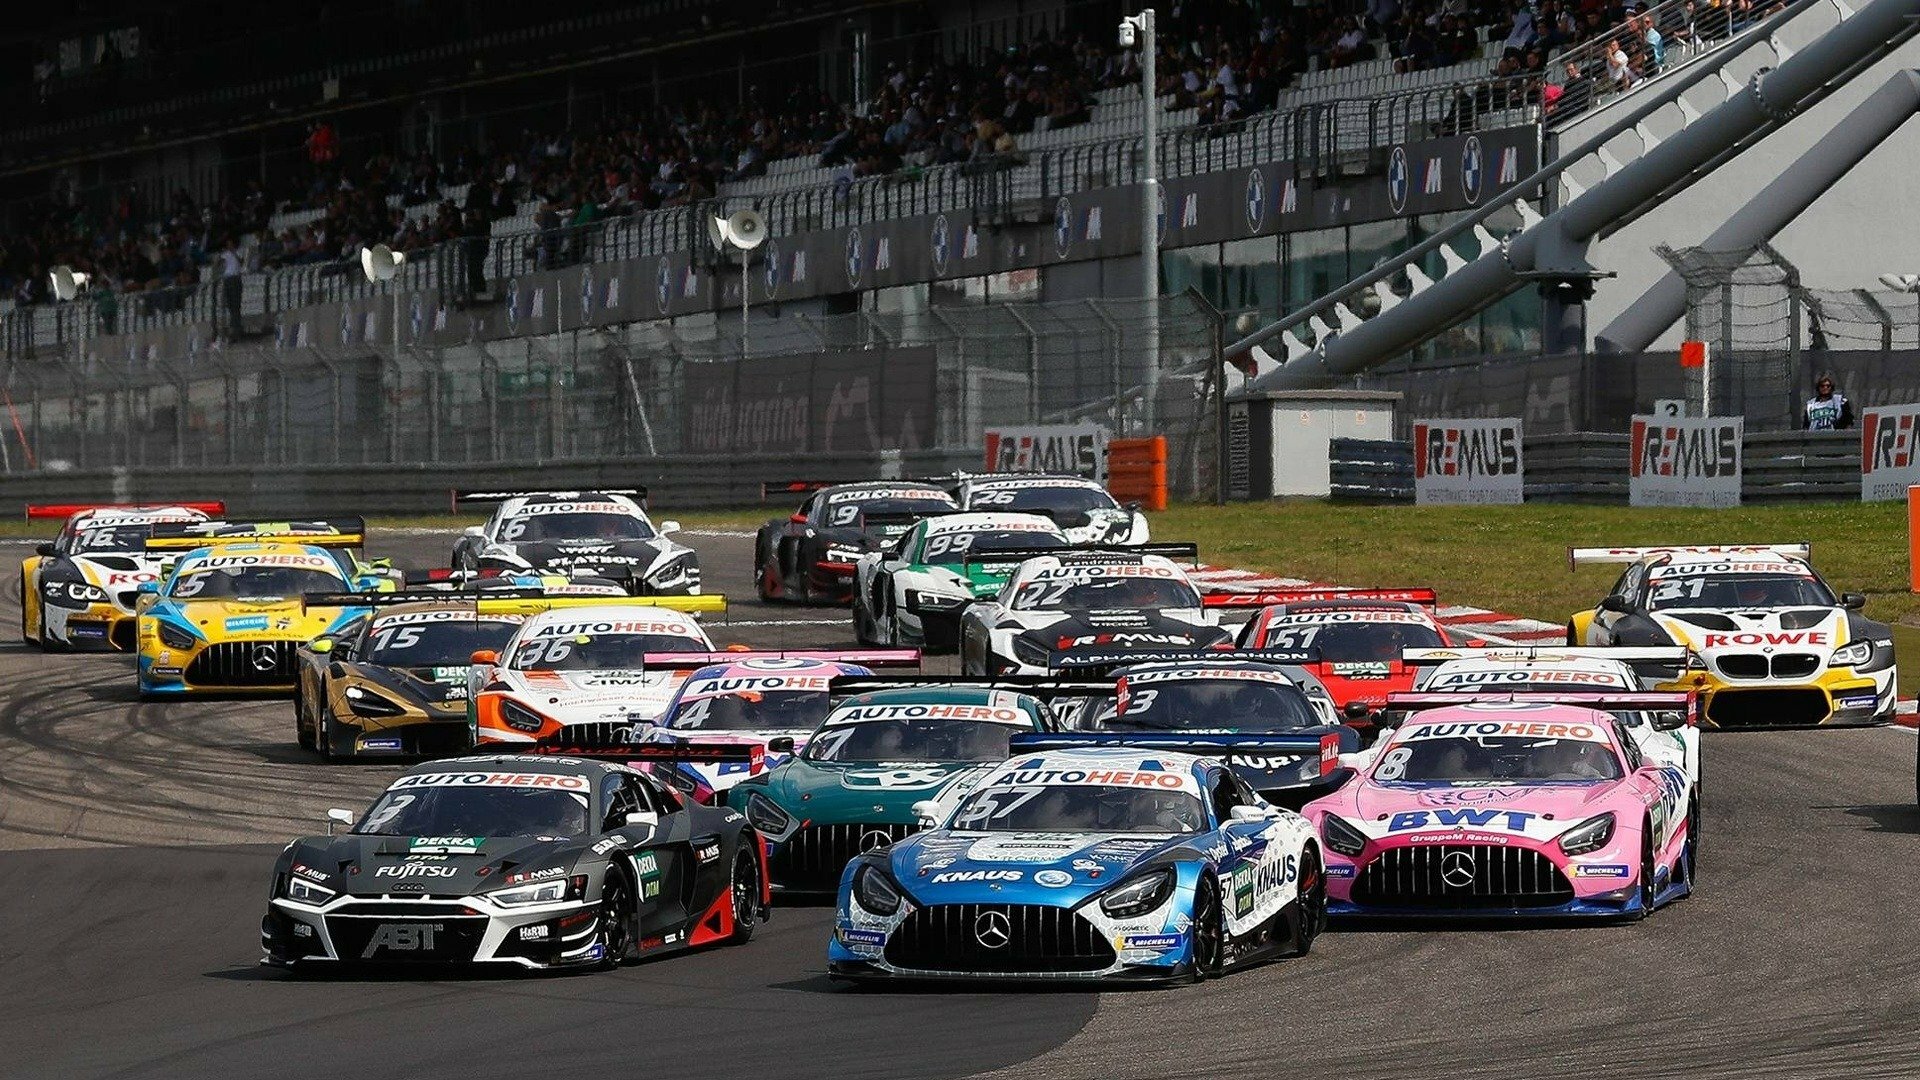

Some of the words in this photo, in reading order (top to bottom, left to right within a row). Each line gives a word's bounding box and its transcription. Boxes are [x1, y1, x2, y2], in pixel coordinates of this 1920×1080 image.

[999, 435, 1096, 479] REMUS
[1427, 427, 1518, 480] REMUS
[1641, 426, 1737, 480] REMUS
[972, 490, 1017, 505] 26
[515, 503, 629, 515] AUTOHERO
[833, 505, 859, 526] 9
[503, 516, 530, 541] 6
[931, 523, 1056, 535] AUTOHERO
[81, 528, 117, 547] 16
[929, 533, 975, 557] 99
[194, 556, 324, 573] AUTOHERO
[1034, 566, 1172, 580] AUTOHERO
[1661, 562, 1802, 577] AUTOHERO
[109, 572, 159, 586] RO
[173, 572, 213, 598] 5
[546, 585, 614, 594] HERO
[1017, 581, 1072, 609] 22
[1654, 577, 1705, 602] 31
[1276, 612, 1427, 626] AUTOHERO
[536, 622, 687, 637] AUTOHERO
[373, 627, 426, 651] 15
[1274, 627, 1320, 650] 51
[1704, 632, 1828, 648] ROWE
[520, 638, 573, 667] 36
[1334, 660, 1388, 670] DEKRA
[697, 678, 829, 694] AUTOHE
[1440, 670, 1615, 685] AUTOHERO
[672, 698, 711, 728] 4
[839, 705, 1018, 722] AUTOHERO
[1409, 722, 1594, 739] AUTOHERO
[1374, 747, 1414, 781] 8
[396, 774, 583, 789] AUTOHERO
[995, 769, 1184, 789] AUTOHERO
[958, 786, 1047, 823] 57
[1387, 808, 1537, 832] BWT
[414, 837, 475, 847] DEKRA
[1410, 833, 1464, 844] GruppeM
[1466, 833, 1508, 844] Racing
[375, 864, 459, 880] FUJITSU
[932, 870, 1023, 884] KNAUS
[1257, 854, 1297, 897] KNAUS
[361, 923, 435, 959] ABT
[1135, 936, 1176, 947] MICHELIN
